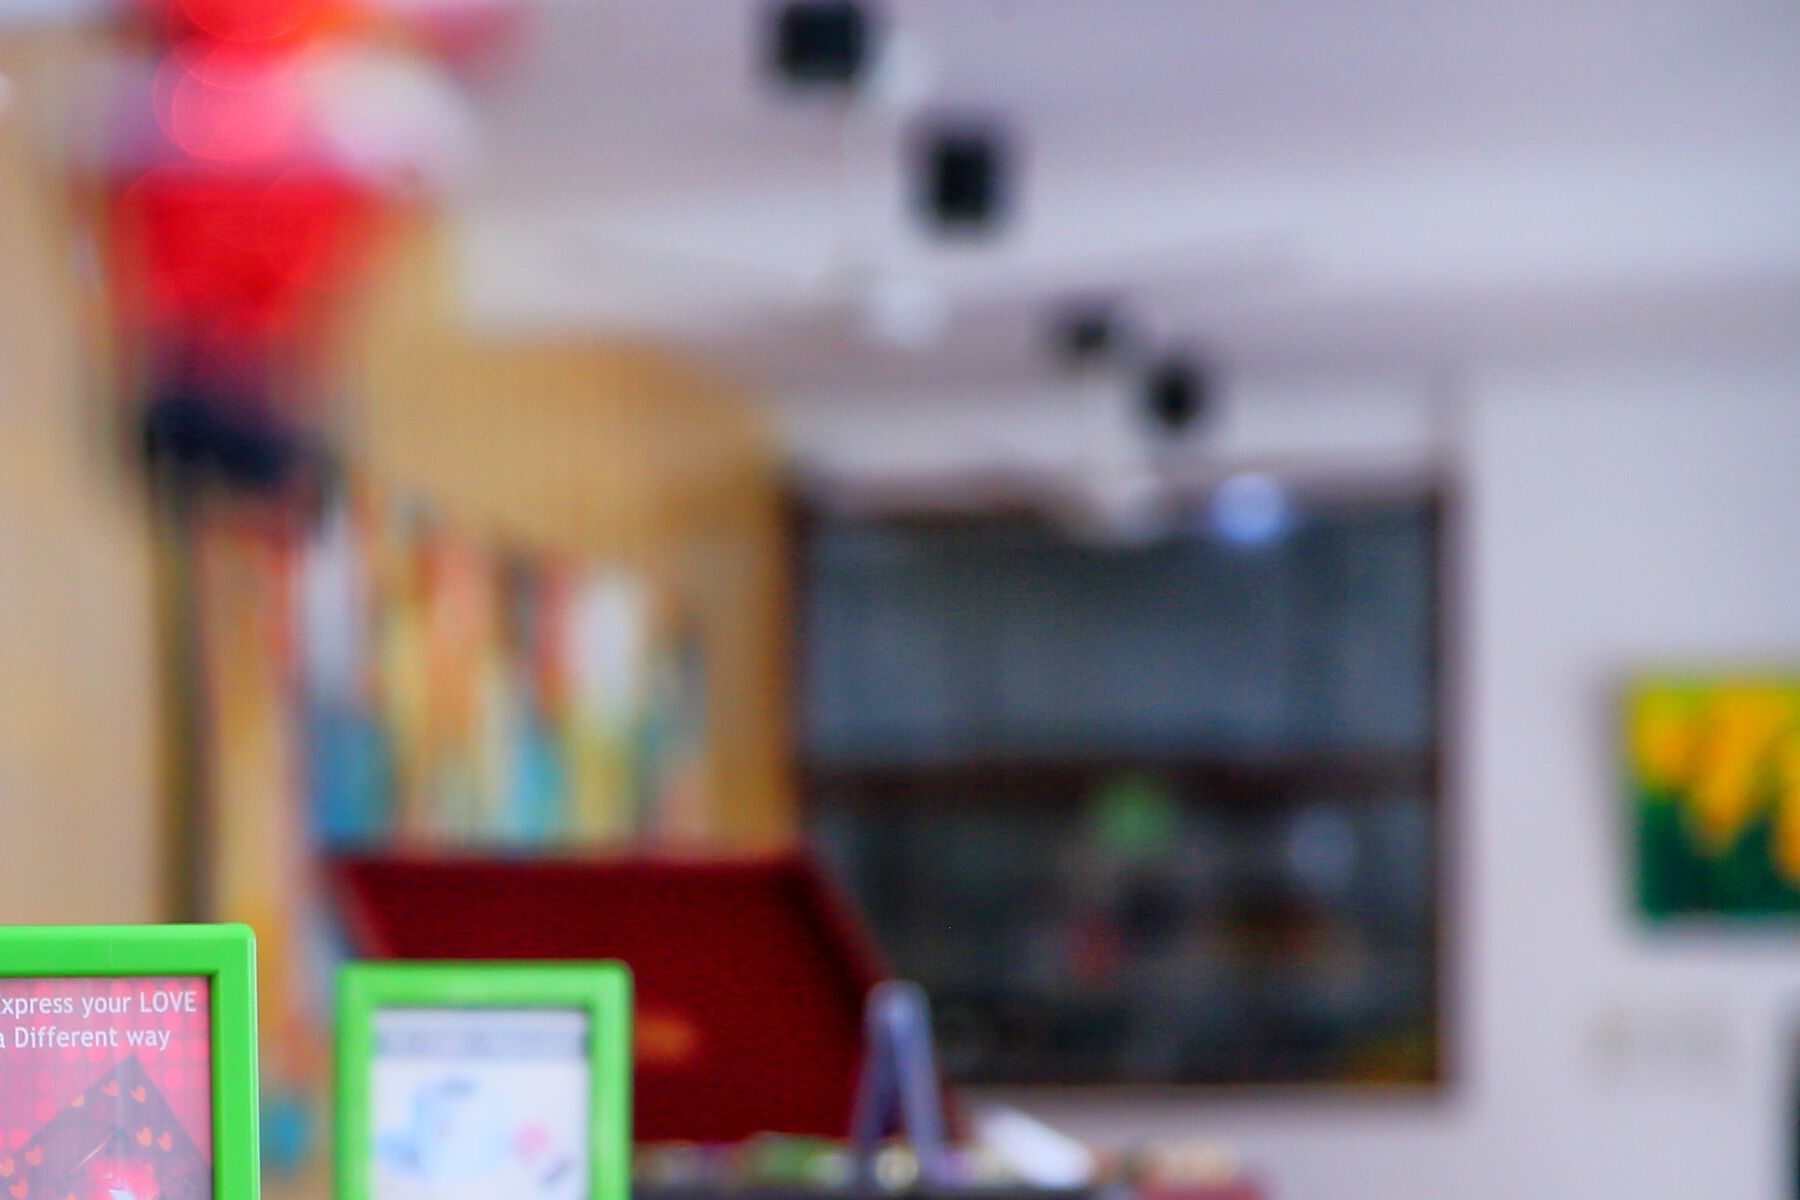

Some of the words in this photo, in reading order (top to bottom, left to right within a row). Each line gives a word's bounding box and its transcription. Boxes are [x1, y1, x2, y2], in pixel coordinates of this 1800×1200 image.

[81, 995, 132, 1018] your
[140, 991, 197, 1013] LOVE
[15, 1027, 119, 1049] Different
[126, 1030, 171, 1051] way
